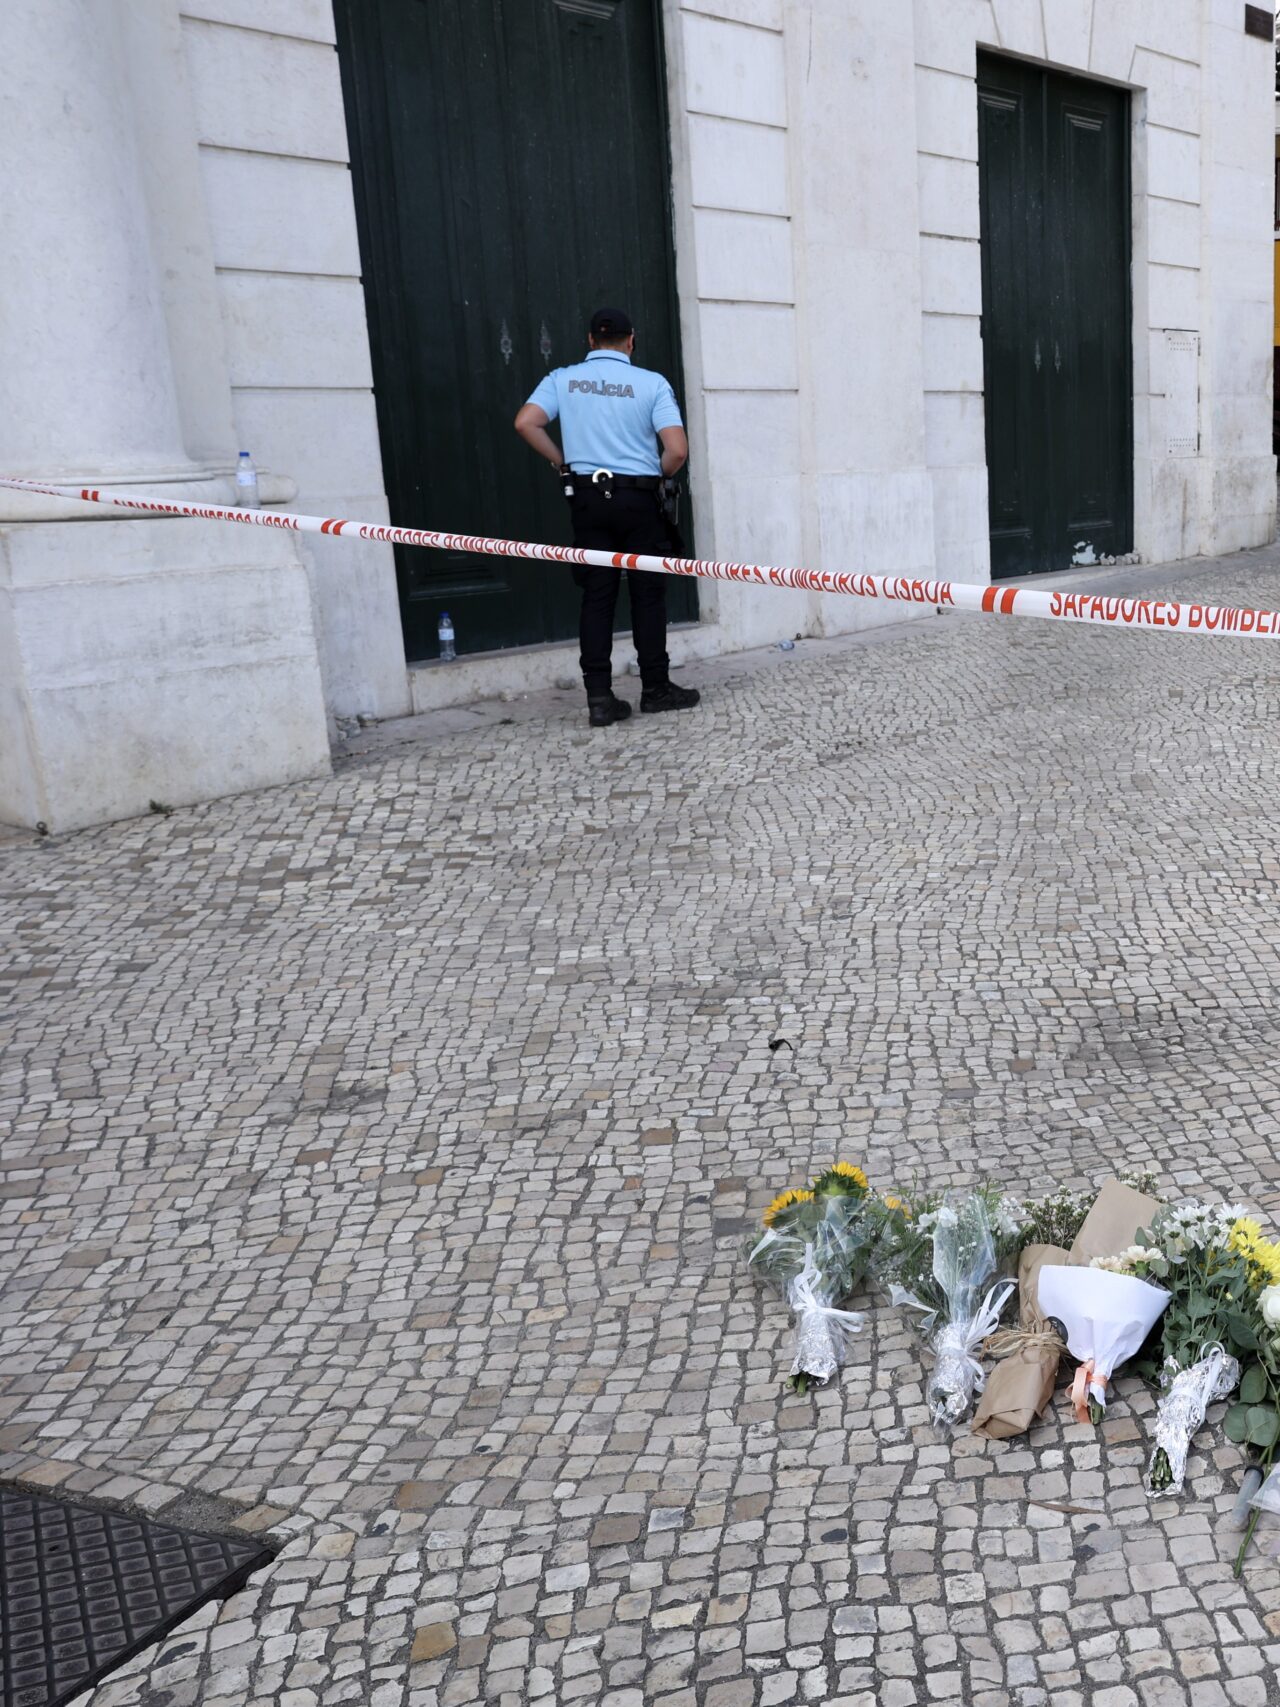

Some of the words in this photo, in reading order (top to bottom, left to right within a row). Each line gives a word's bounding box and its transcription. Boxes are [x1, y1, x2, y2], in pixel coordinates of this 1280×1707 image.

[568, 380, 635, 399] POLÍCIA
[662, 557, 767, 584] SAPADORES
[769, 567, 878, 598] BOMBEIROS
[883, 577, 955, 605] LISBOA
[1050, 591, 1181, 627] SAPADORES
